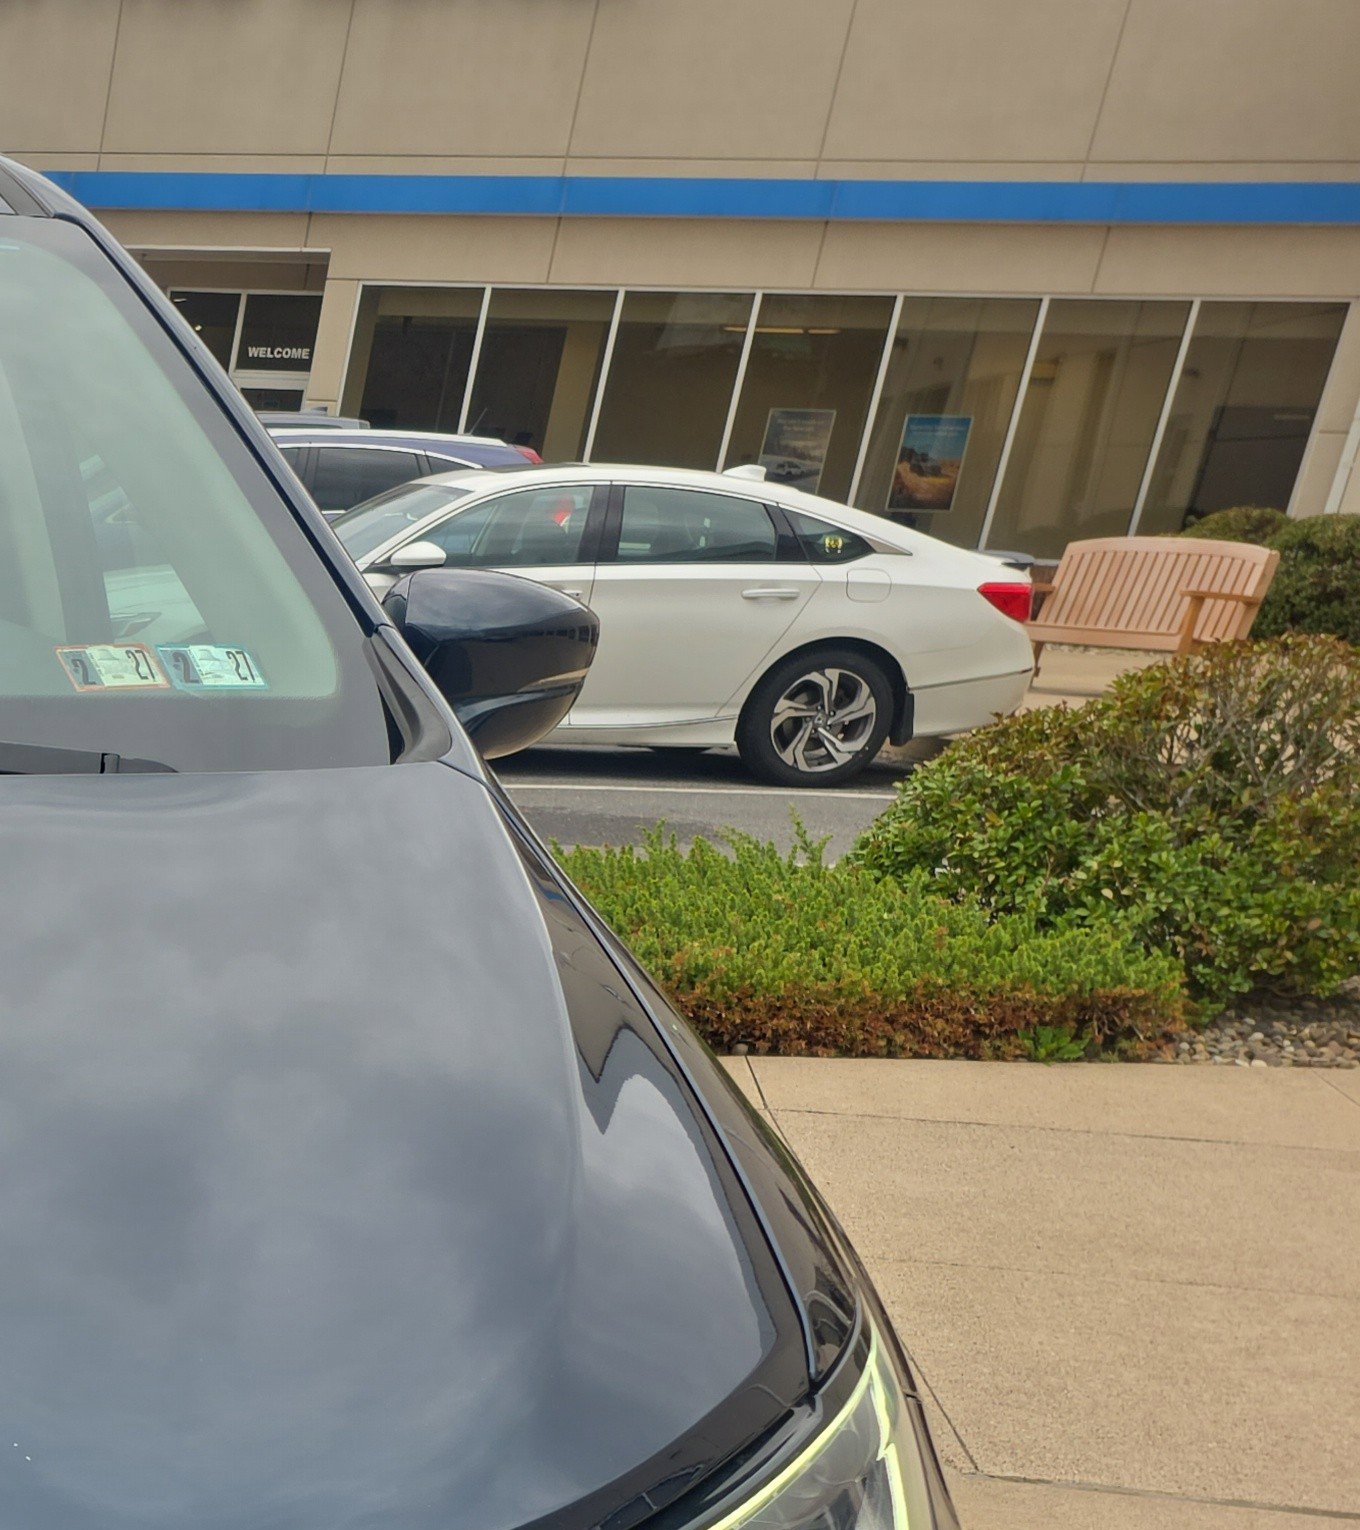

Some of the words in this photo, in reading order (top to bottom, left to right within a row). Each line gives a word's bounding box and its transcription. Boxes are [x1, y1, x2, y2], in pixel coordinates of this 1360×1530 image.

[247, 346, 310, 360] WELCOME
[125, 650, 156, 683] 27
[225, 650, 256, 683] 27
